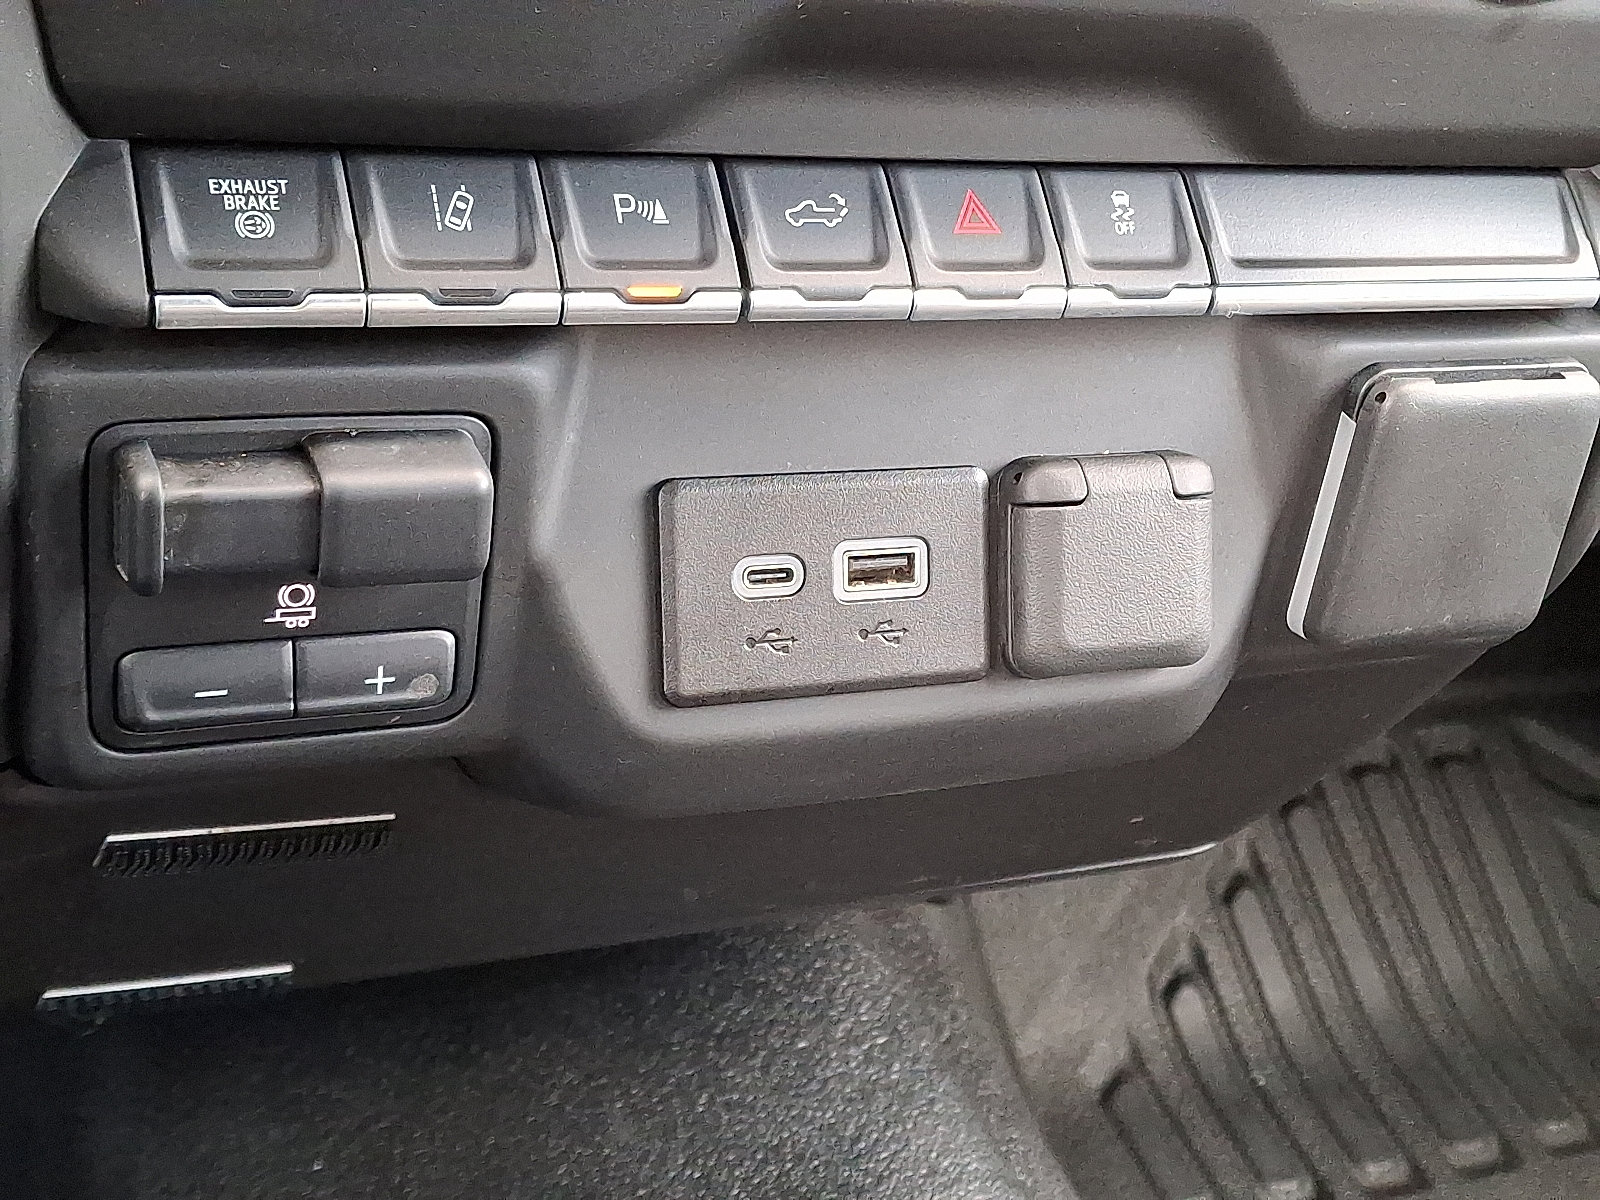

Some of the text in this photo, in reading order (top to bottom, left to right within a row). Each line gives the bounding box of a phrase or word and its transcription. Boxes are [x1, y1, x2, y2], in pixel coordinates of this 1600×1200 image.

[208, 179, 288, 194] EXHAUST
[223, 194, 280, 210] BRAKE
[613, 193, 635, 224] P
[1114, 221, 1135, 235] OFF
